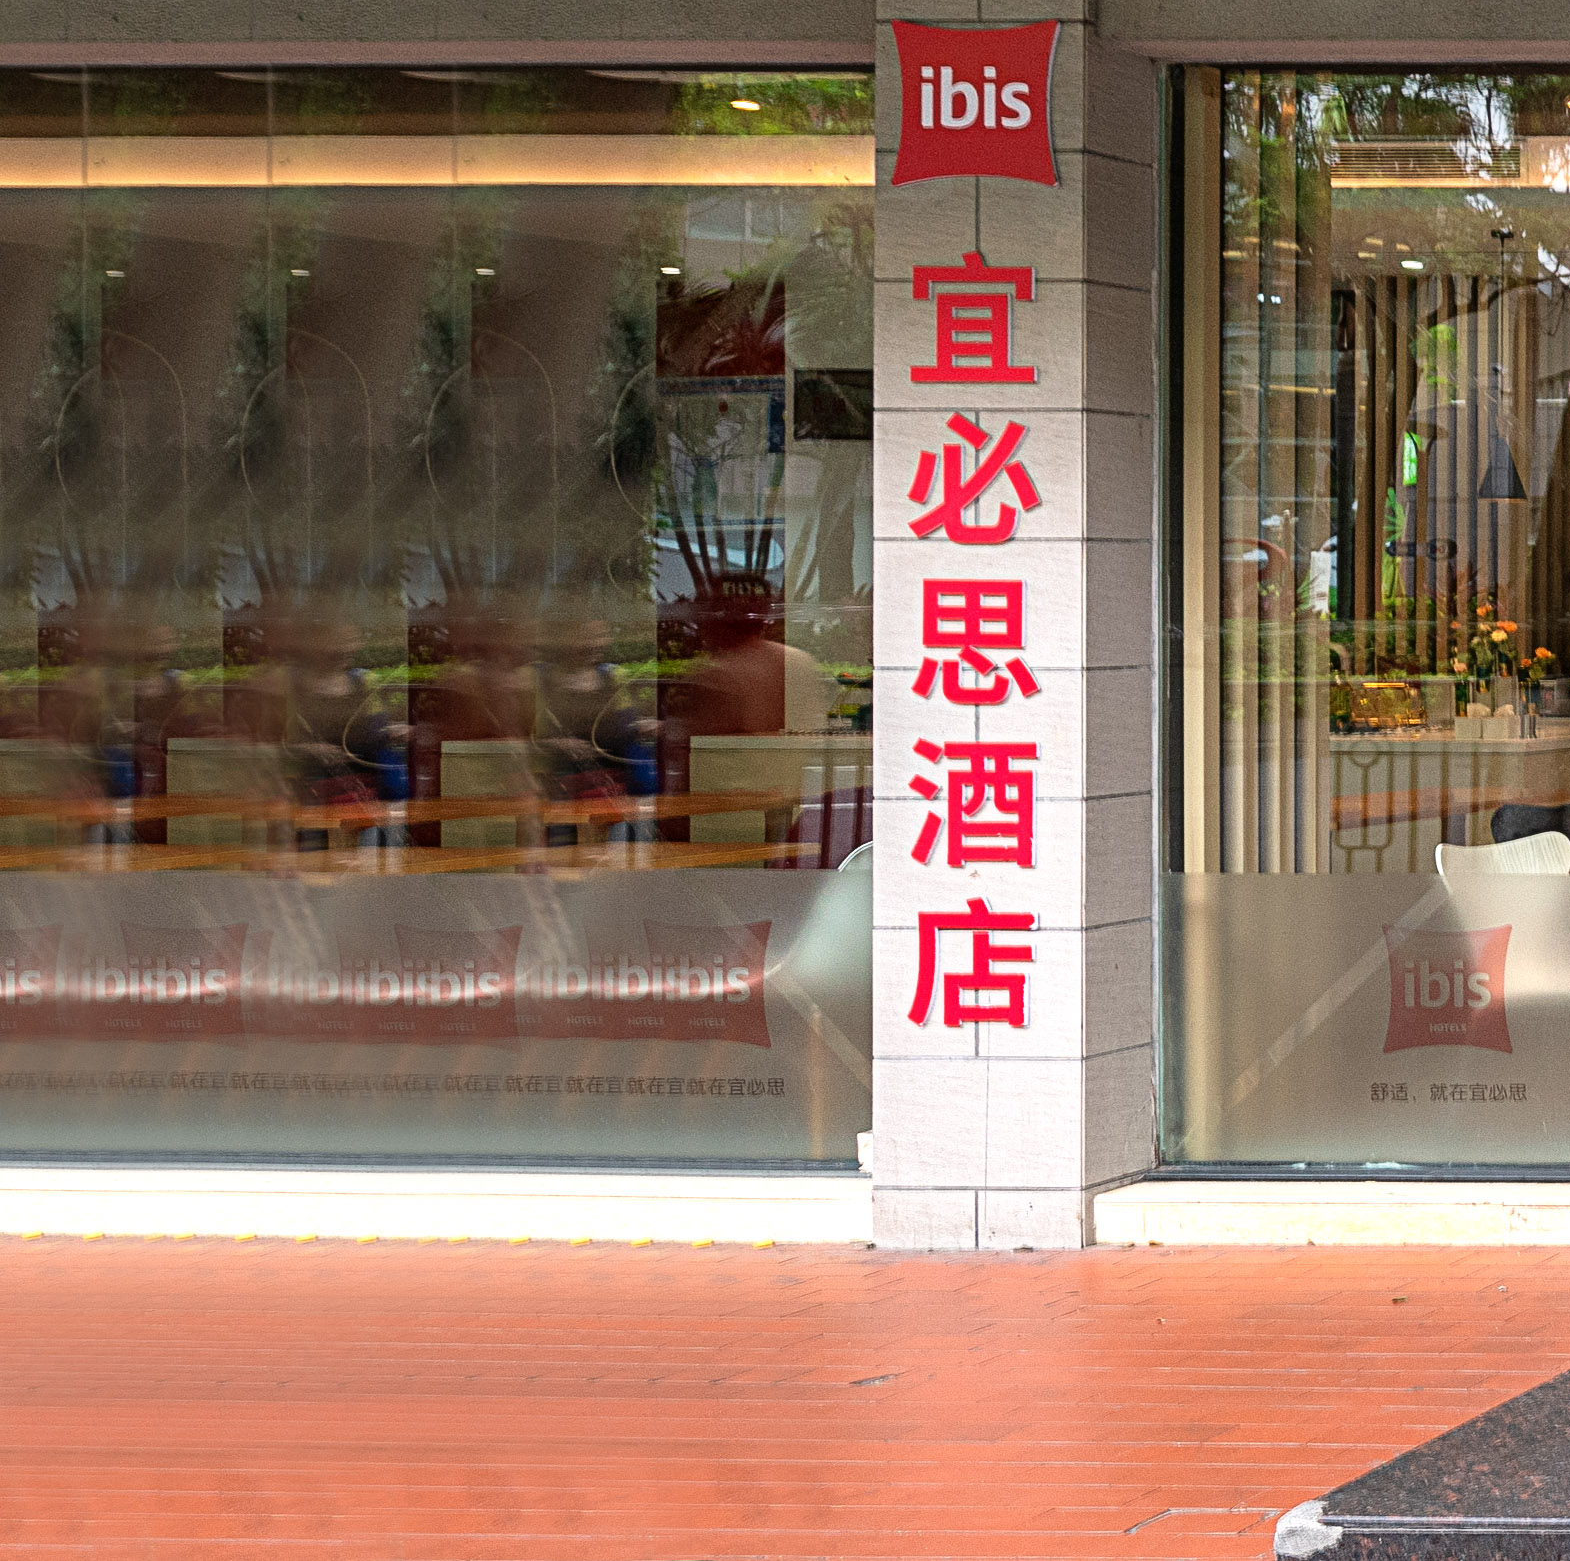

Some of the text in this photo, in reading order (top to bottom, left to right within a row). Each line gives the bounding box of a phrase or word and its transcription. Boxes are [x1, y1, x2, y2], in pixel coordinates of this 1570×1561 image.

[919, 65, 1033, 132] ibis
[906, 249, 1044, 1030] 宜必思酒店
[1402, 959, 1491, 1009] ibis
[1429, 1023, 1468, 1033] HOTELS
